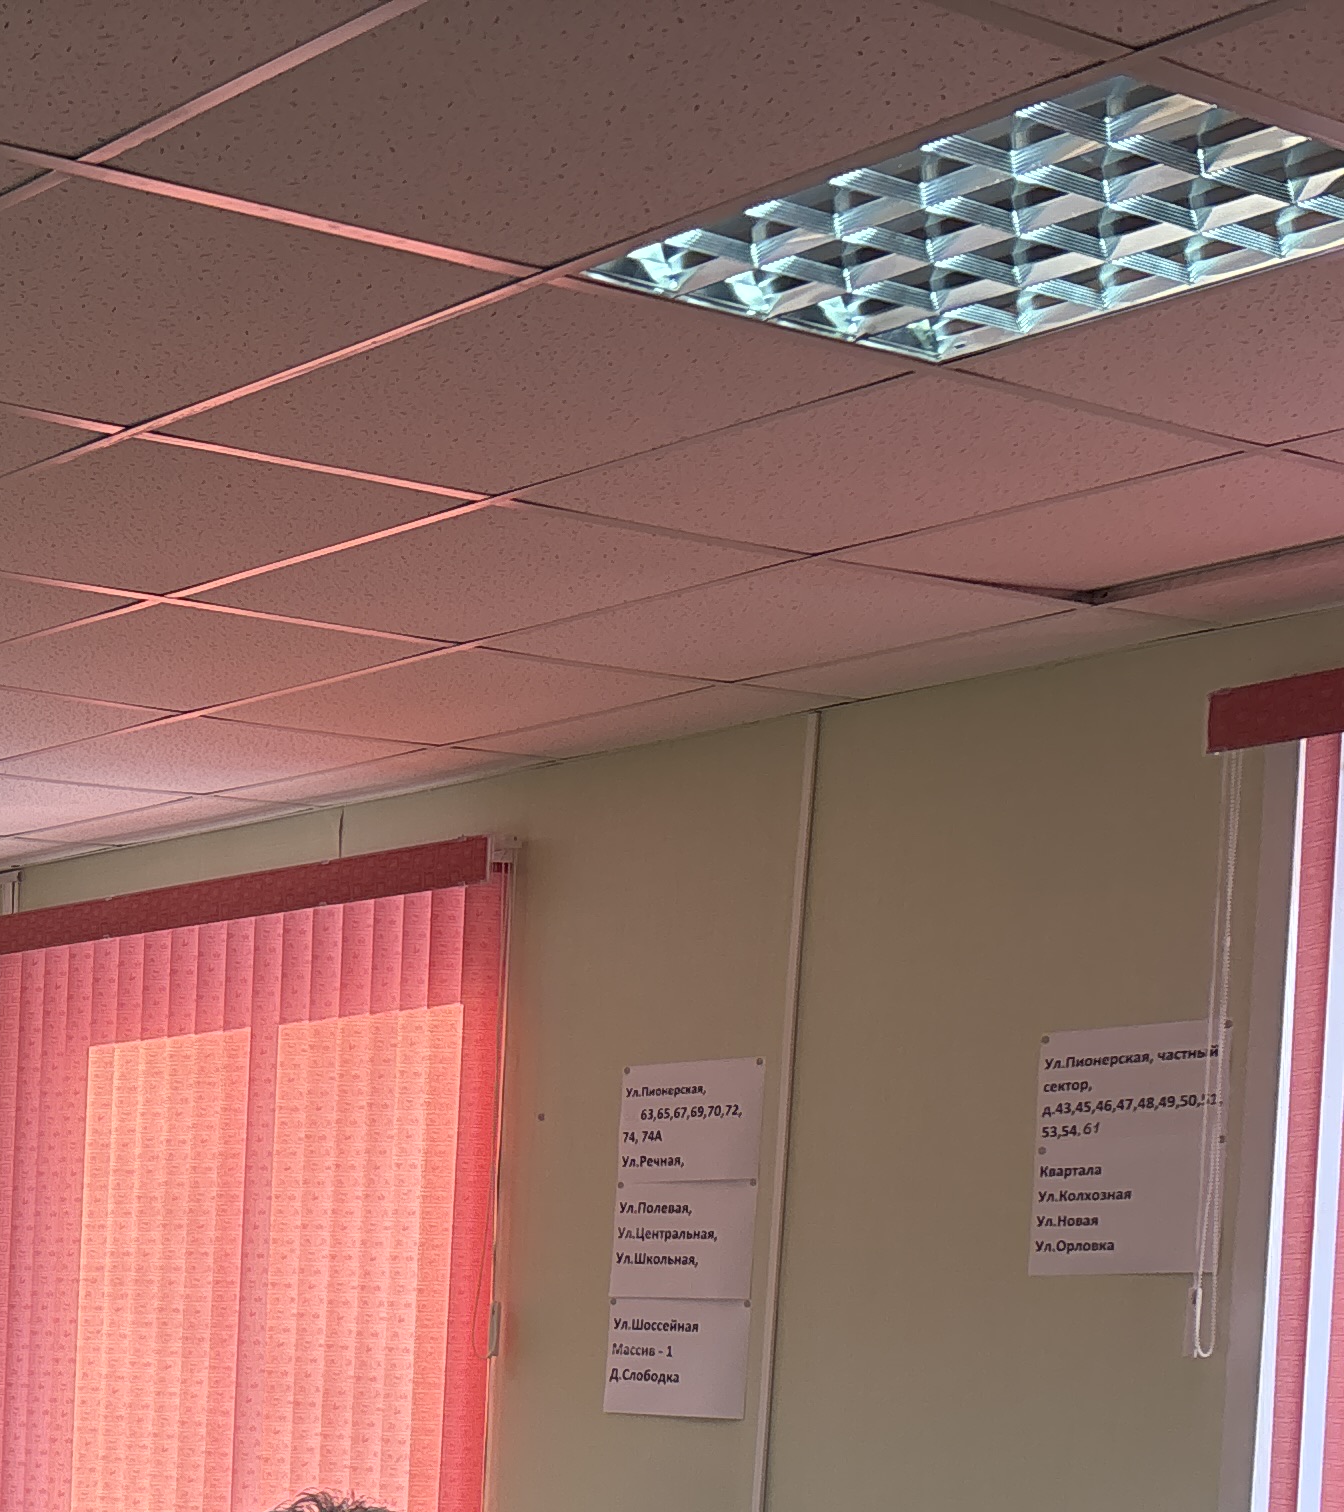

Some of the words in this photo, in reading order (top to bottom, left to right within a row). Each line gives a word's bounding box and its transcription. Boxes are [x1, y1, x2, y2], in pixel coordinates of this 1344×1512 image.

[1045, 1053, 1154, 1070] Ул.Пионерская,
[1157, 1044, 1218, 1061] частный
[1044, 1081, 1092, 1092] сектор,
[623, 1132, 638, 1144] 74,
[622, 1156, 684, 1168] Ул.Речная,
[1040, 1166, 1102, 1179] Квартала
[1039, 1190, 1132, 1203] Ул.Колхозная
[620, 1202, 692, 1216] Ул.Полевая,
[1037, 1215, 1098, 1227] Ул.Новая
[618, 1227, 717, 1242] Ул.Центральная,
[1036, 1240, 1114, 1254] Ул.Орловка
[616, 1252, 698, 1268] Ул.Школьная,
[614, 1318, 698, 1332] Ул.Шоссейная
[612, 1343, 655, 1356] Массив
[666, 1346, 672, 1357] 1
[609, 1368, 679, 1385] Д.Слободка
